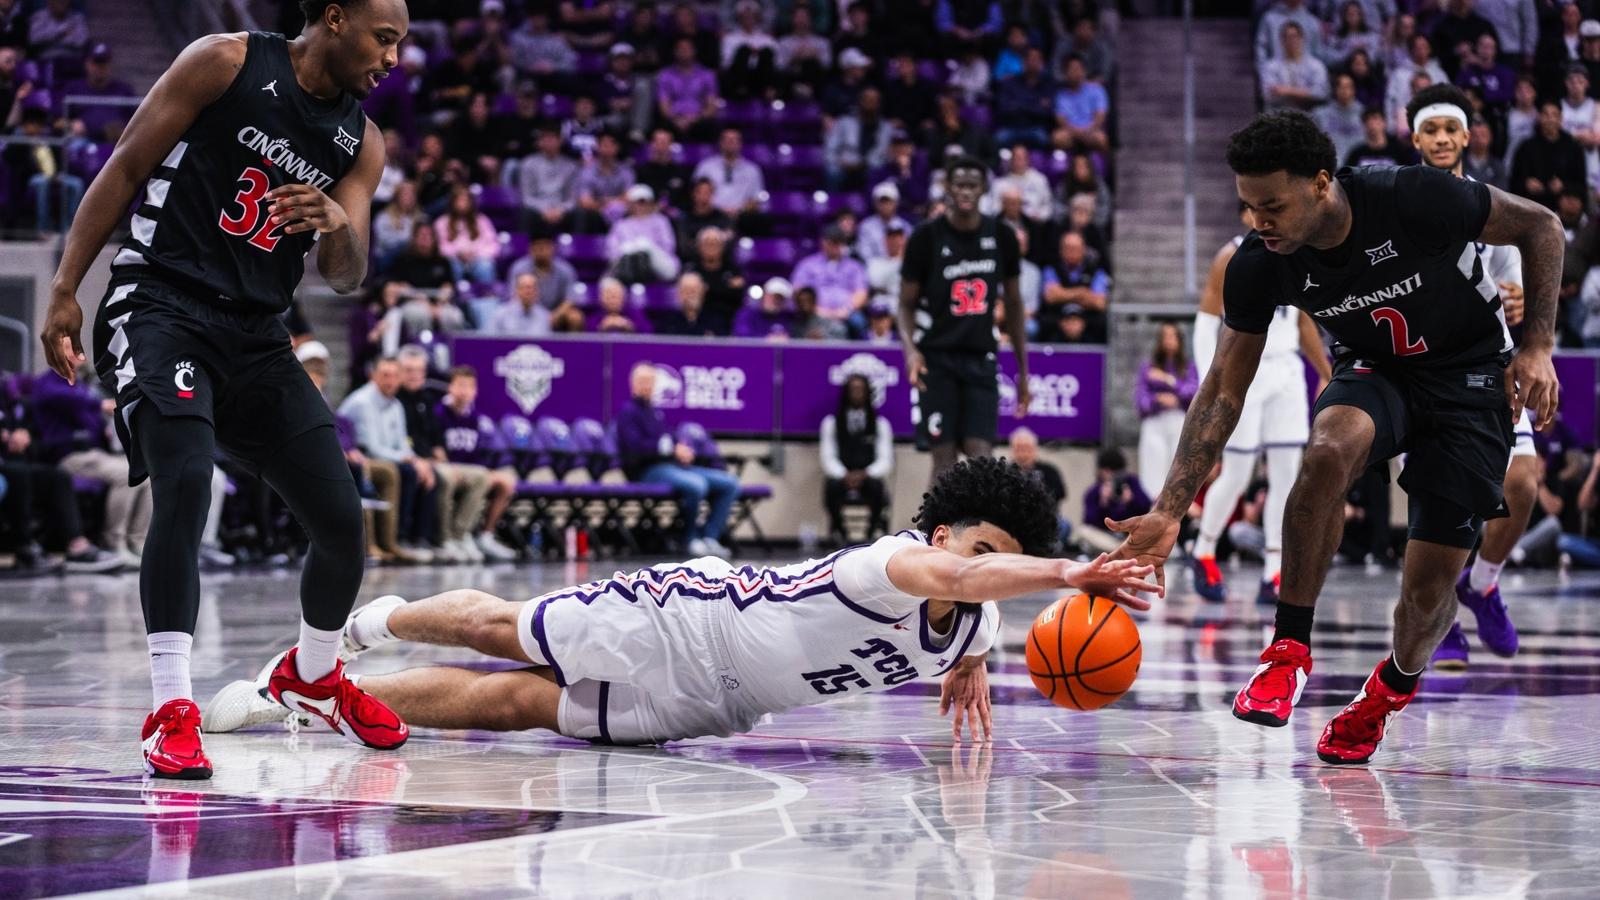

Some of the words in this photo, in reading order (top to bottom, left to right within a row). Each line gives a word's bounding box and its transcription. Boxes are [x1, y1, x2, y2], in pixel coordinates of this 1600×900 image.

[237, 126, 335, 190] CINCINNATI
[950, 278, 989, 316] 52
[1314, 272, 1422, 318] CINCINNATI
[1370, 307, 1428, 356] 2
[681, 366, 746, 390] TACO
[684, 387, 745, 410] BELL
[801, 664, 871, 694] 15
[850, 638, 919, 685] TCU
